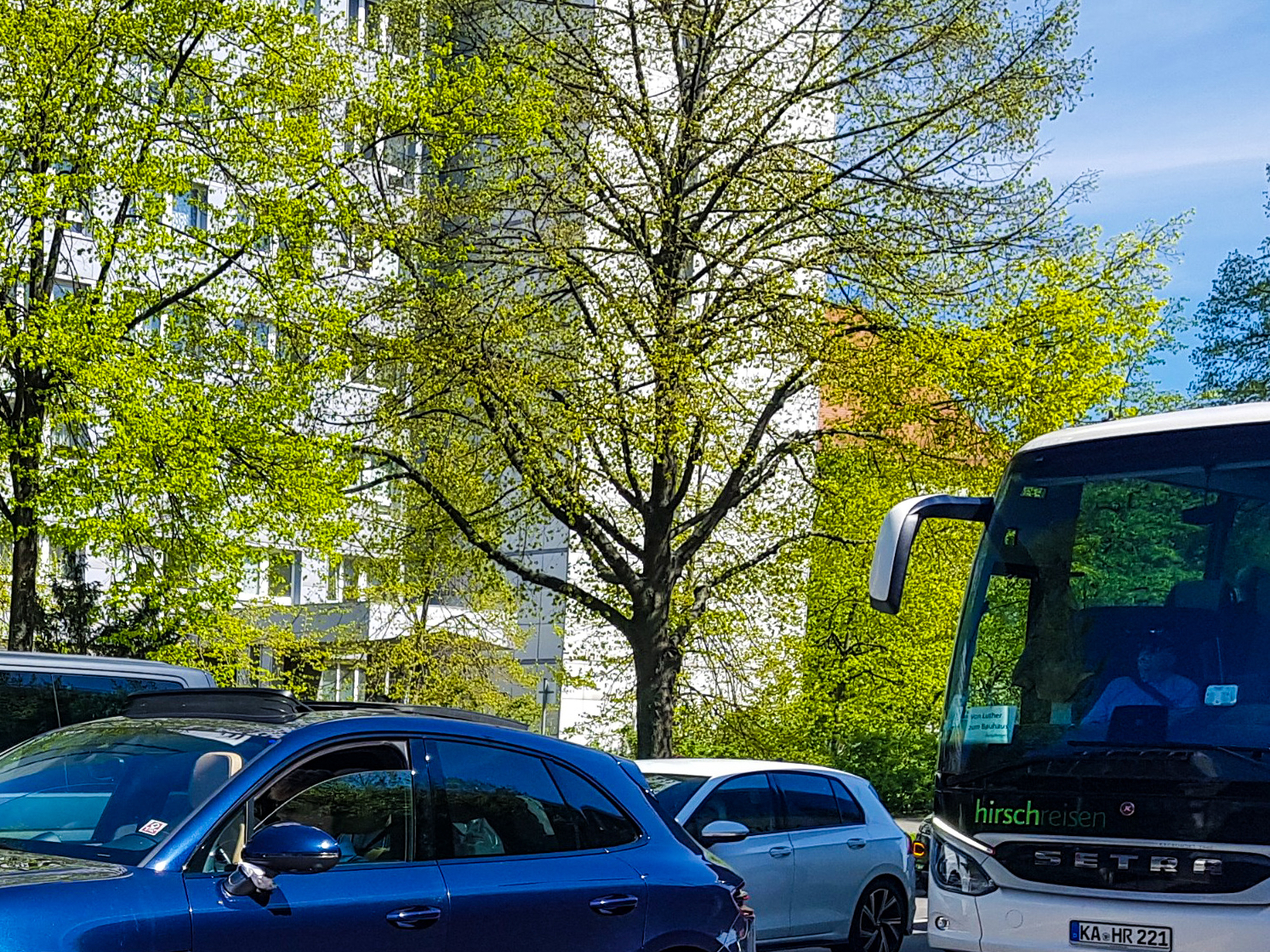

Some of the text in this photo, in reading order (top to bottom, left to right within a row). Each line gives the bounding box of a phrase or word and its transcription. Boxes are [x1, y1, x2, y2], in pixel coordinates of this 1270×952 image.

[974, 798, 1106, 828] hirschreisen
[1034, 850, 1223, 876] SETRA
[1080, 925, 1101, 941] KA
[1111, 927, 1133, 944] HR
[1137, 929, 1168, 946] 221
